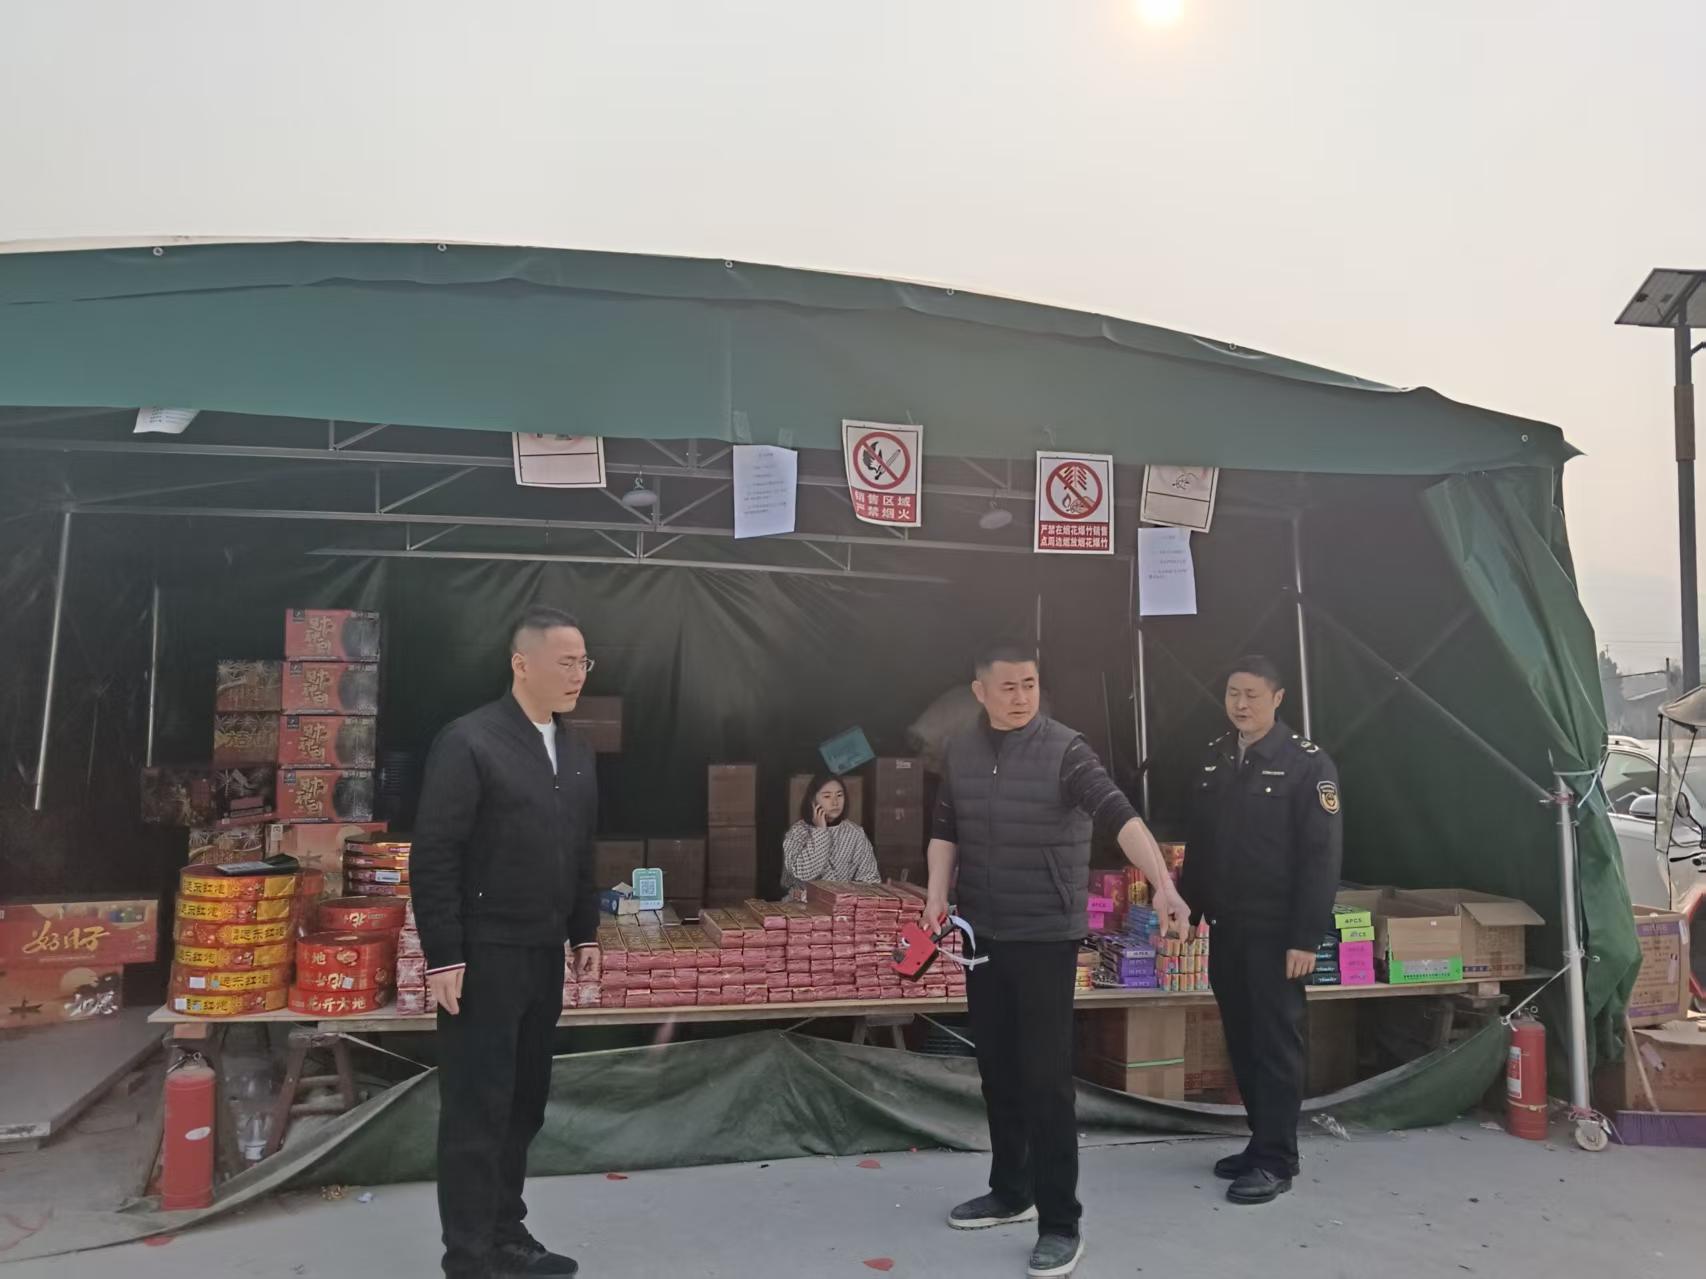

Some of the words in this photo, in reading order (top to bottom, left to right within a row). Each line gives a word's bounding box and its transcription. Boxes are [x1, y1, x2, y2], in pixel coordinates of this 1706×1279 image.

[855, 490, 911, 507] 销售区域
[856, 502, 911, 520] 严禁烟火
[1040, 524, 1109, 536] 严禁在烟花爆竹销售
